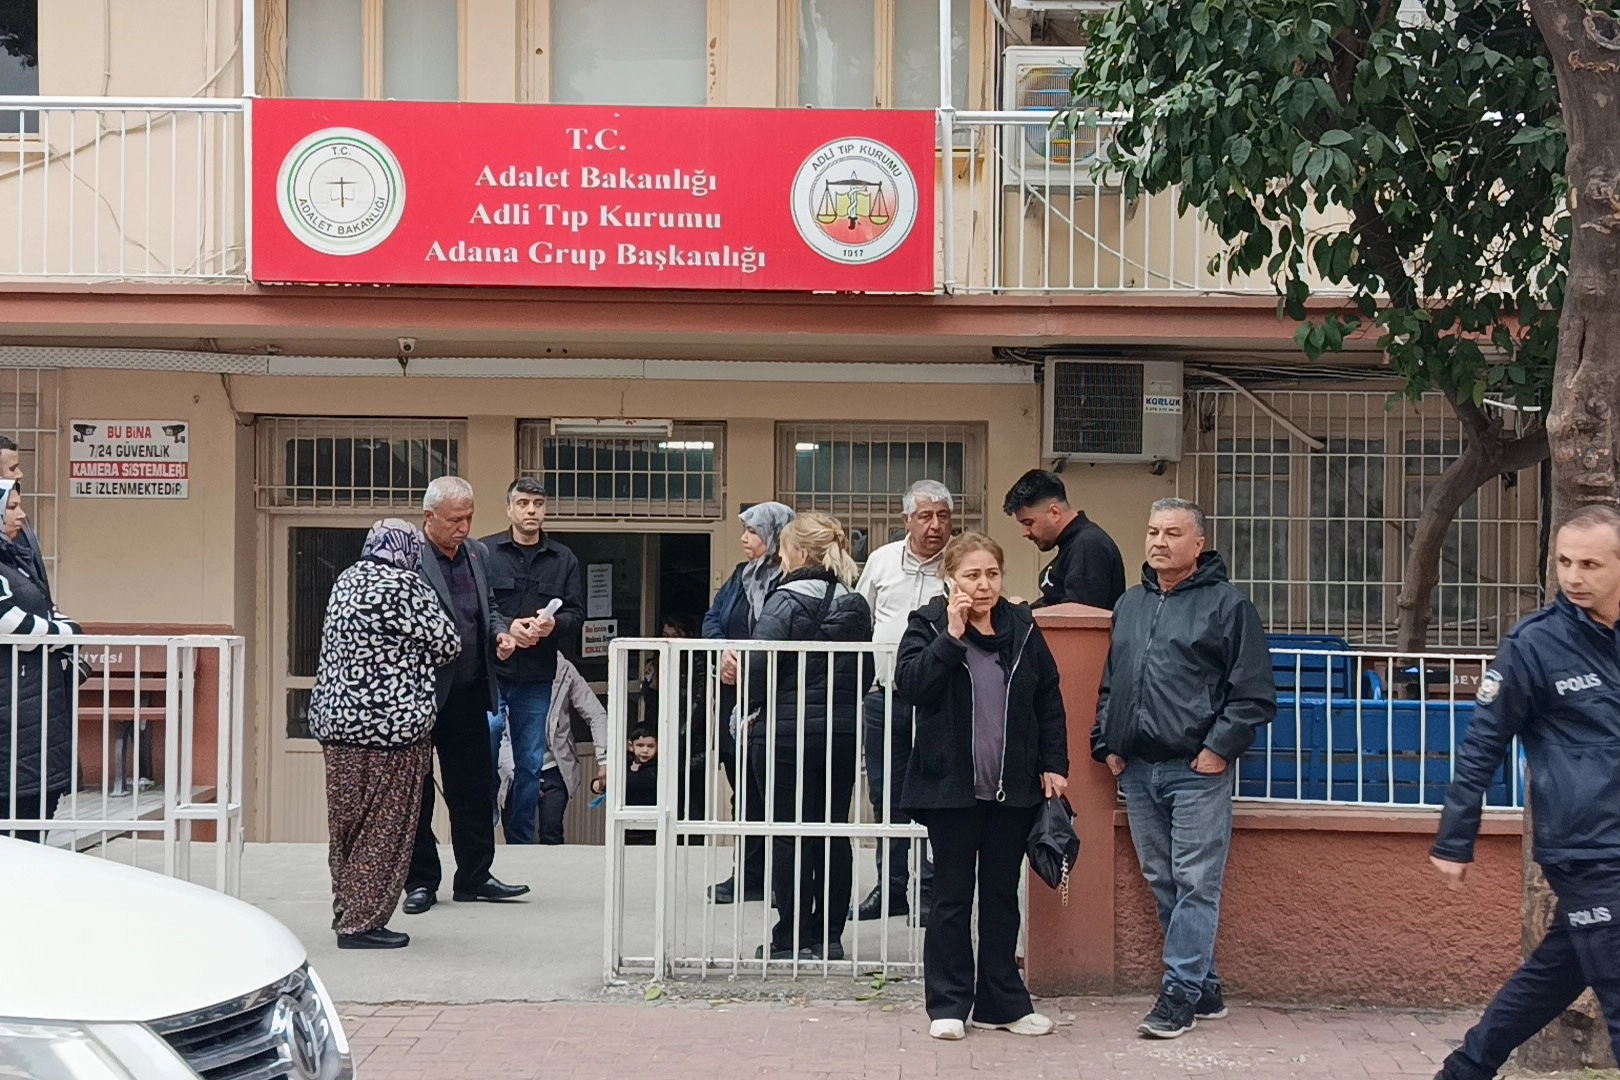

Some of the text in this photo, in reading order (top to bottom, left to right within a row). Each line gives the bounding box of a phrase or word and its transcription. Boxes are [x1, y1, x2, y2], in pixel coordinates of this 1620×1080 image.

[331, 146, 352, 156] T.C.
[565, 128, 626, 150] T.C.
[811, 144, 903, 177] ADLİ TIP KURUMU
[475, 165, 717, 197] Adalet Bakanlığı
[298, 196, 386, 235] ADALET BAKANLIĞI
[469, 203, 721, 232] Adli Tıp Kurumu
[424, 240, 766, 273] Adana Grup Başkanlığı
[107, 426, 121, 439] BU
[89, 444, 112, 458] 7/24
[73, 463, 119, 477] KAMERA
